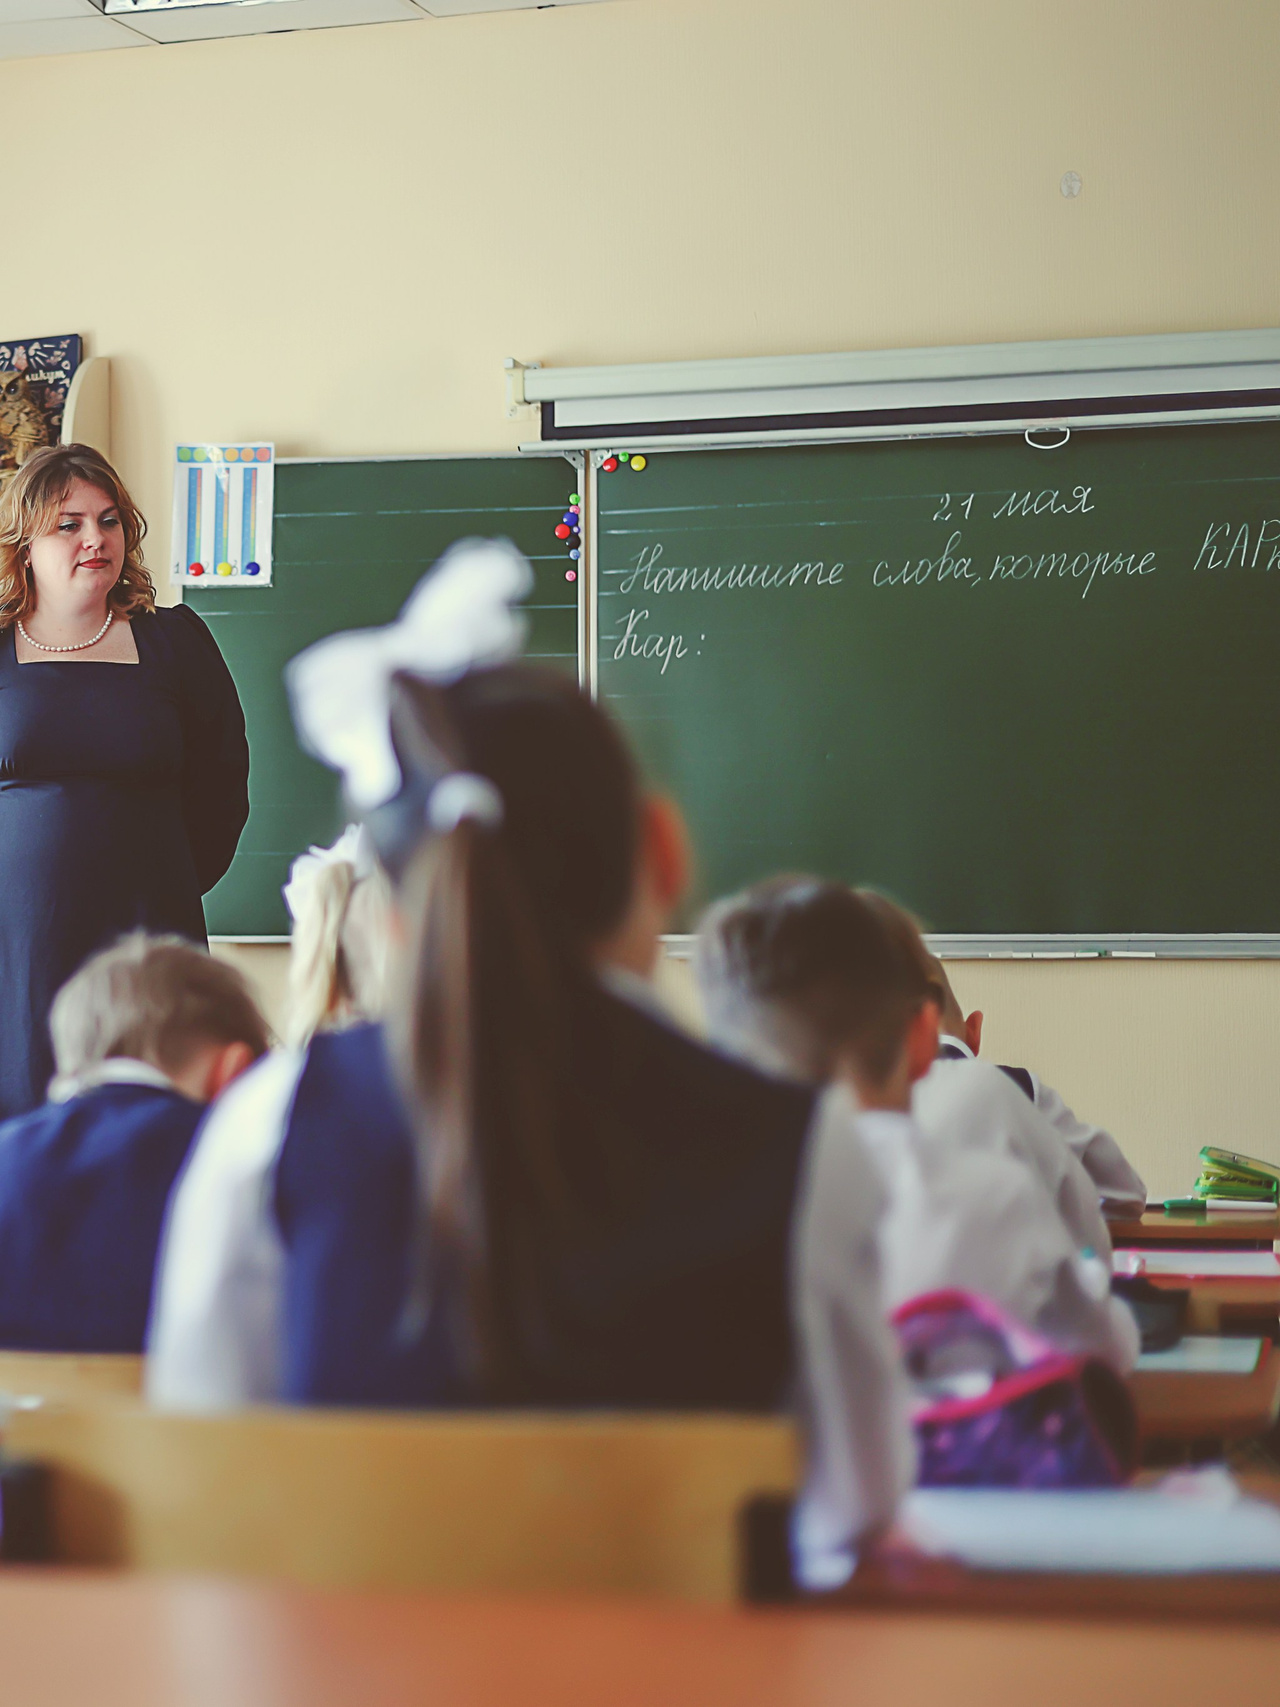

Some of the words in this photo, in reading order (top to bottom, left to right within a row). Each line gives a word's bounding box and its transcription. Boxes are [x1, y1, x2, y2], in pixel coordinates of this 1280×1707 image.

[933, 493, 975, 521] 21
[993, 485, 1095, 519] мая
[620, 543, 845, 594] Напишите
[872, 530, 981, 588] слова,
[989, 551, 1156, 599] которые
